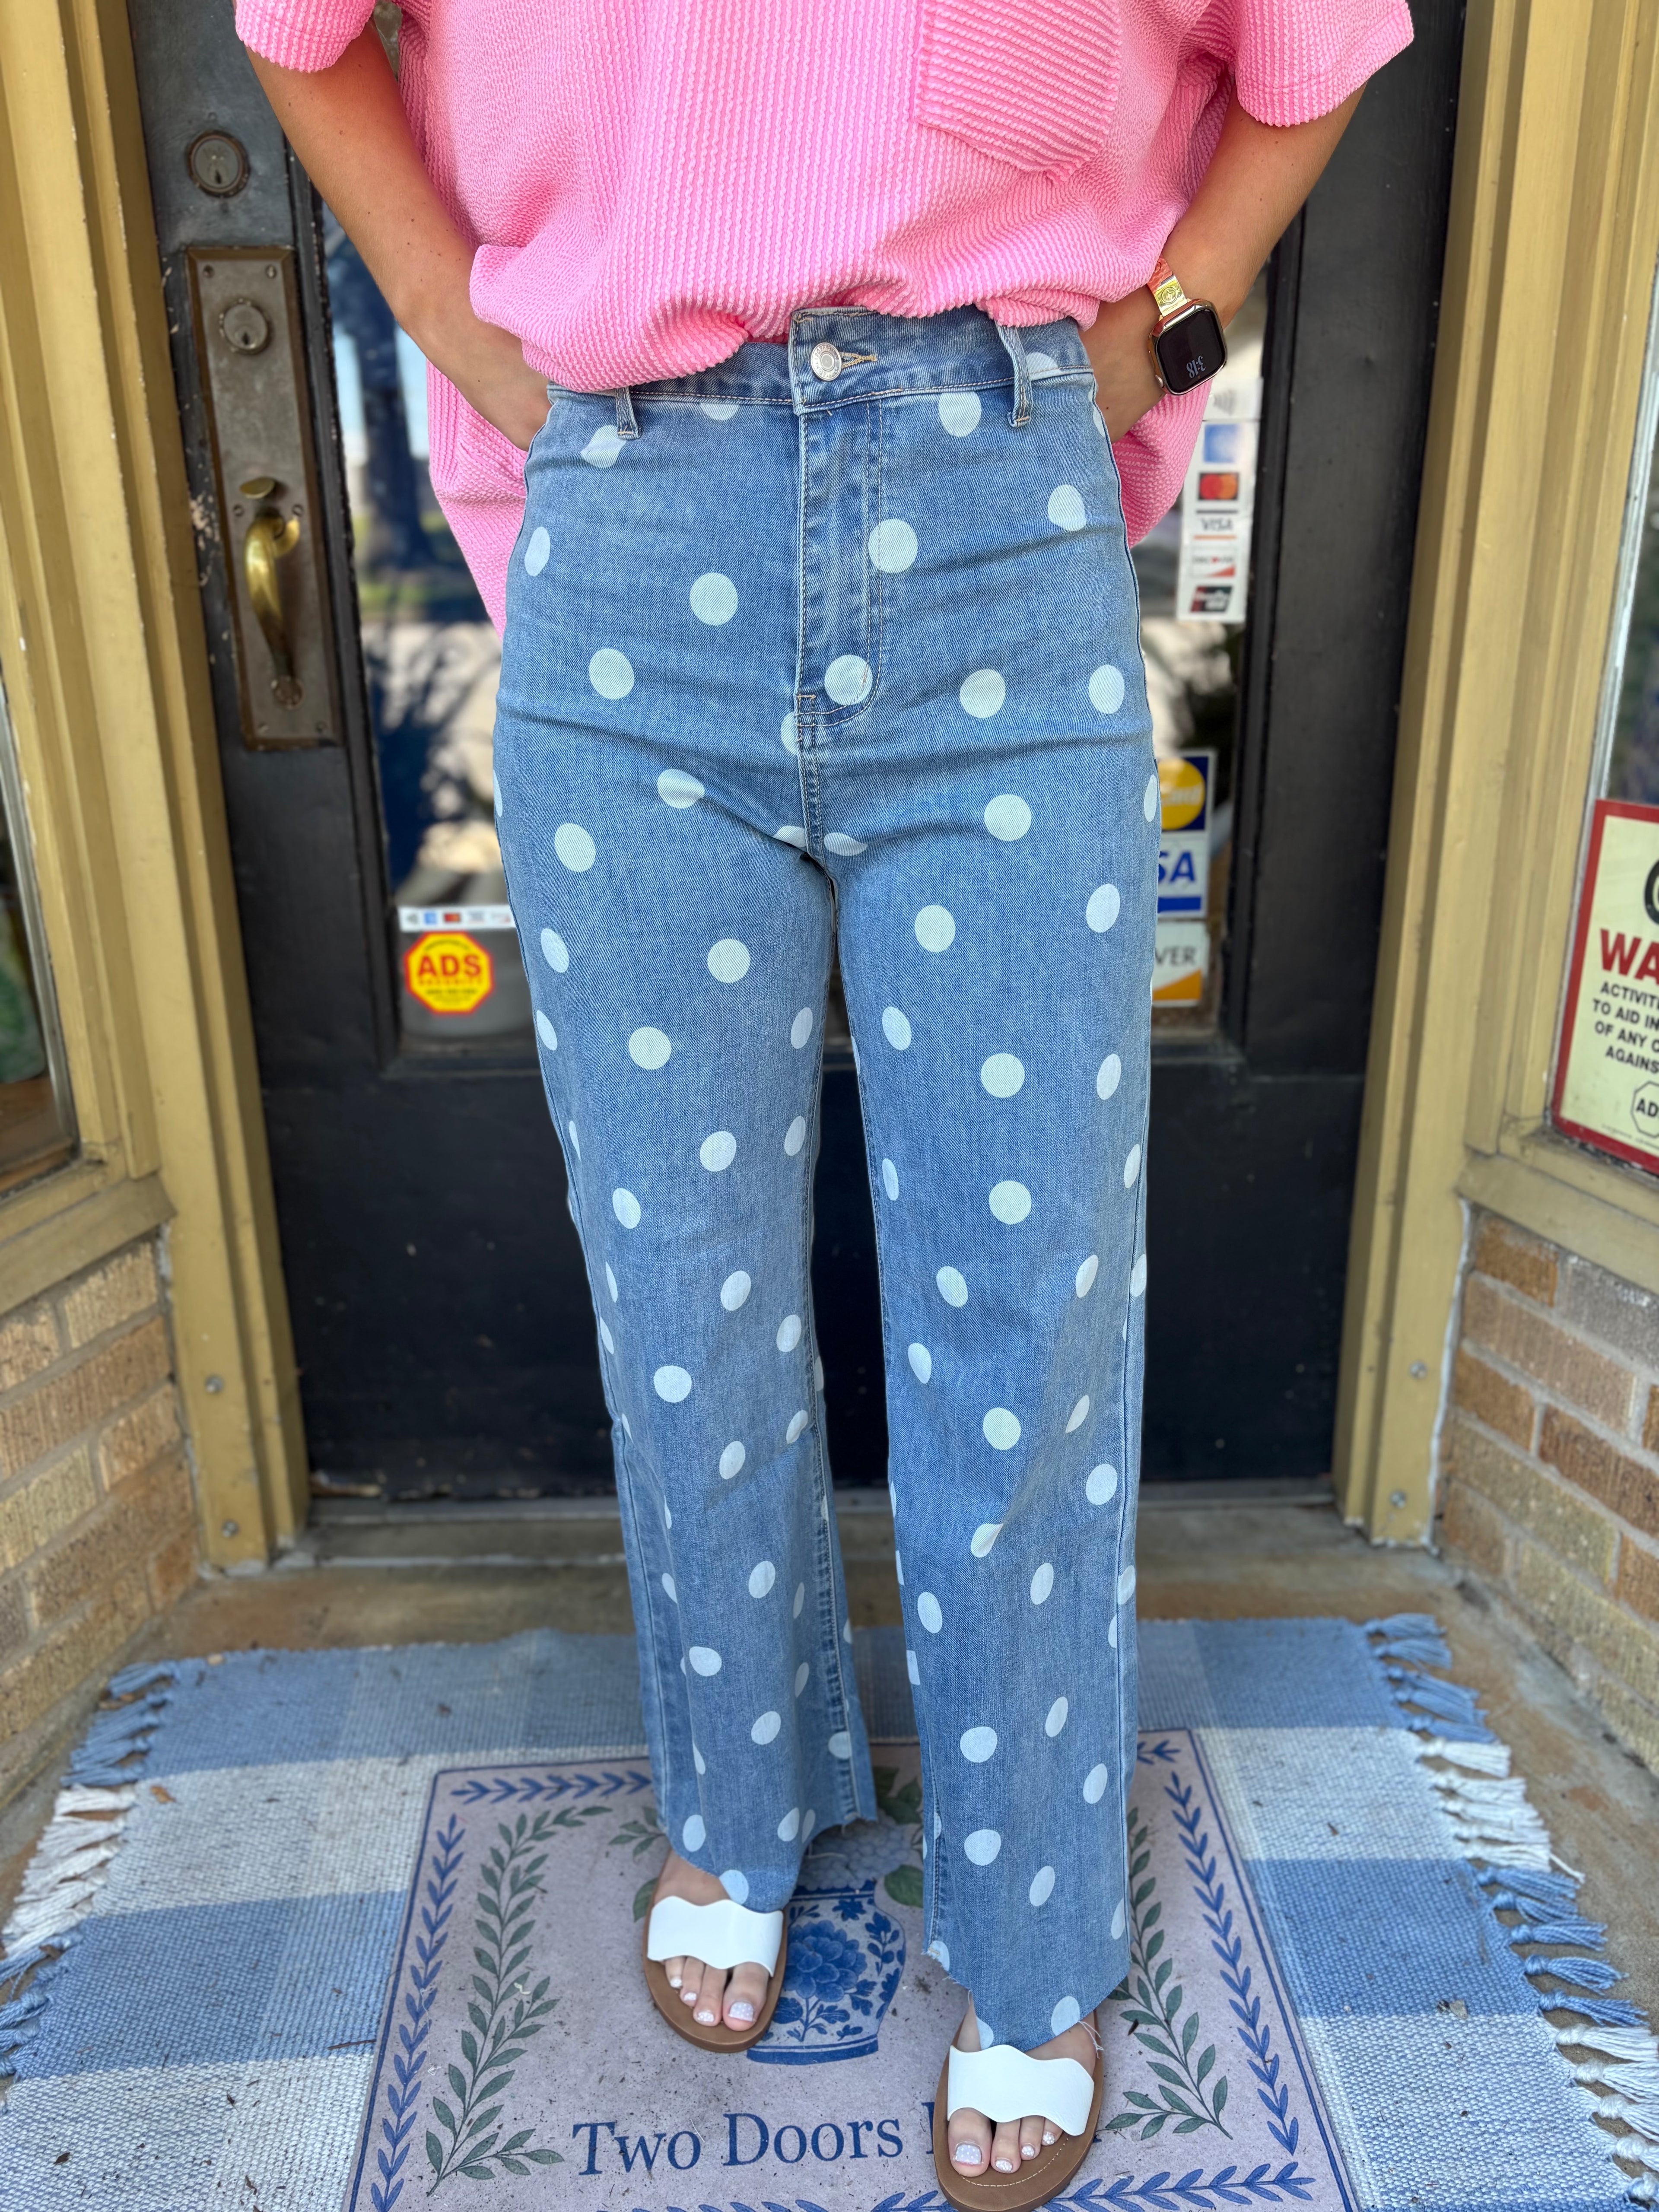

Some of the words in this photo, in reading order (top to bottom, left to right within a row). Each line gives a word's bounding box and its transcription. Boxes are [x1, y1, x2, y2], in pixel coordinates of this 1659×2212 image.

[1186, 355, 1206, 378] 3:18
[418, 954, 481, 977] ADS
[1593, 998, 1611, 1015] TO
[1615, 1007, 1640, 1023] AID
[1595, 1020, 1614, 1036] OF
[1618, 1029, 1647, 1048] ANY
[572, 2122, 701, 2175] Two
[723, 2113, 903, 2166] Doors
